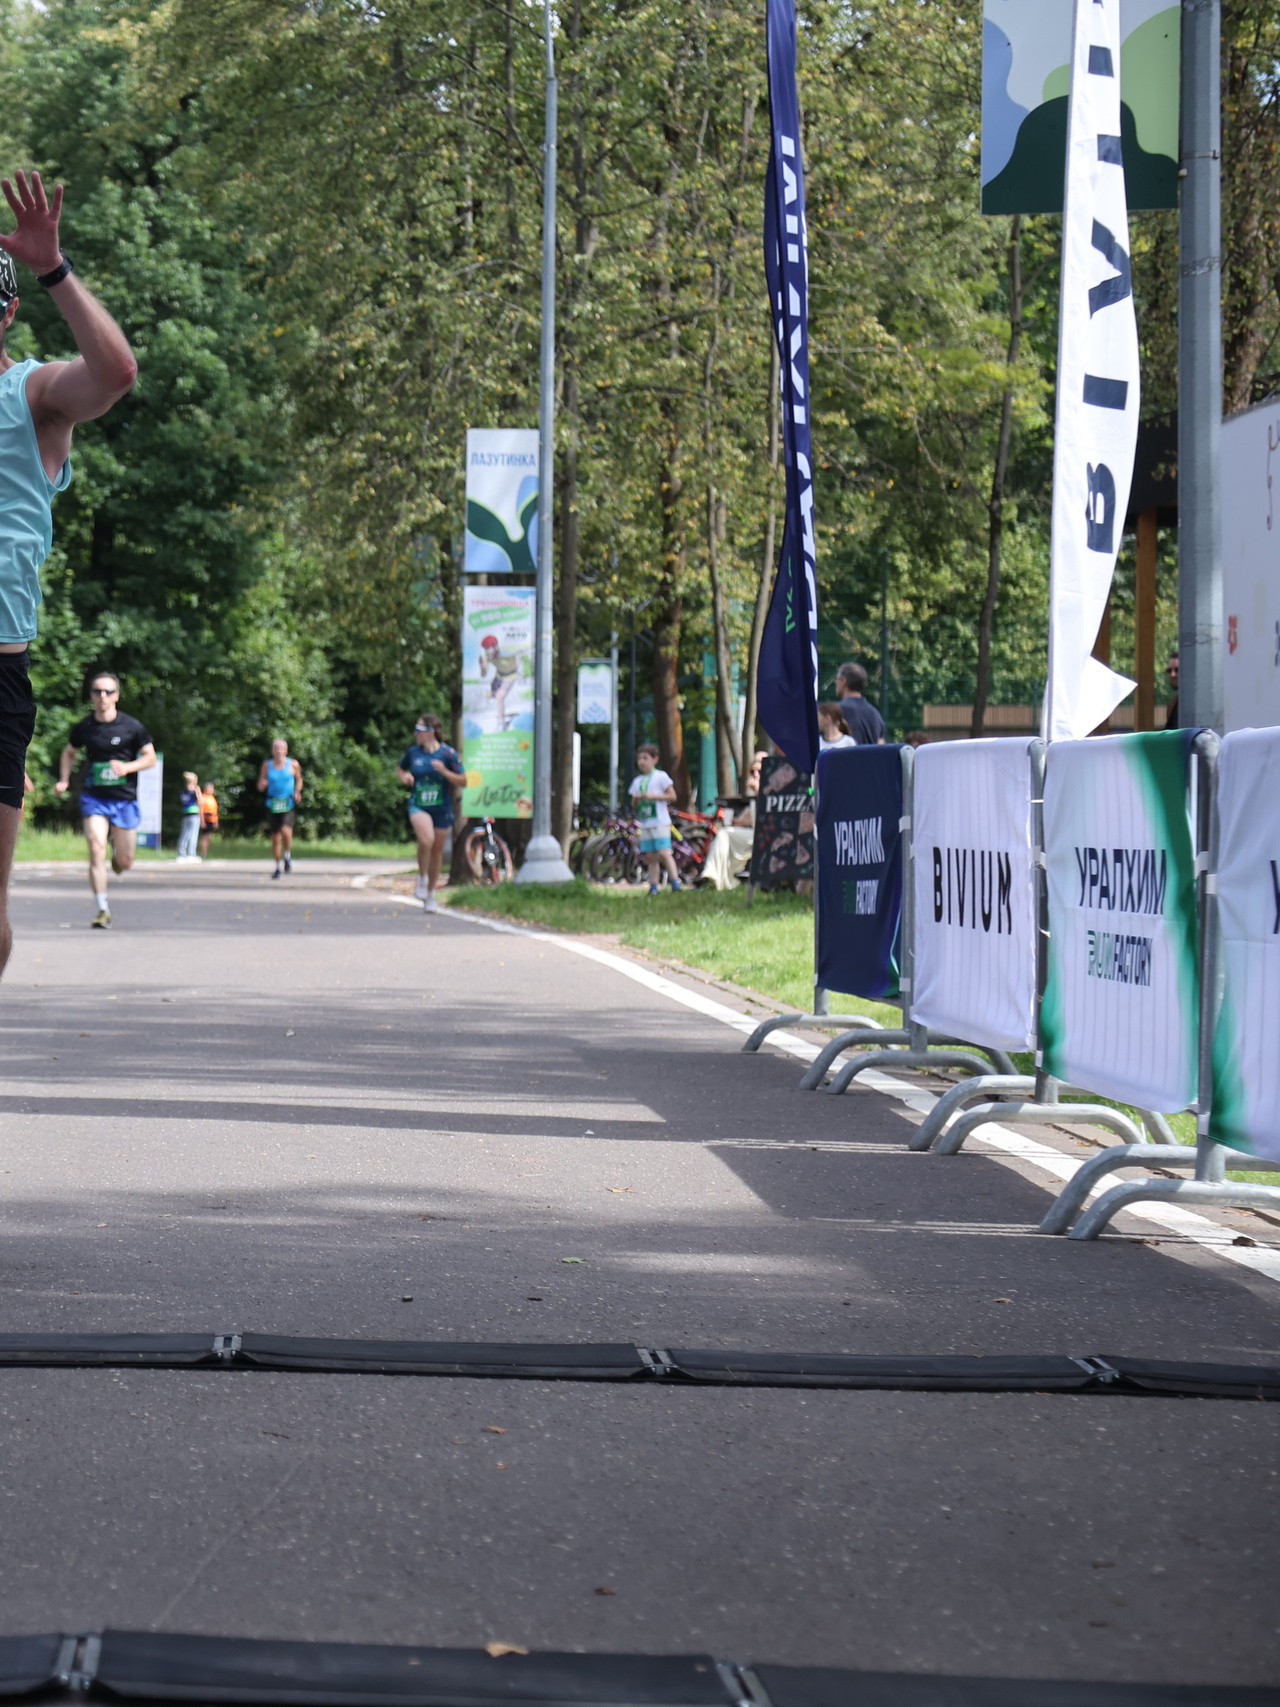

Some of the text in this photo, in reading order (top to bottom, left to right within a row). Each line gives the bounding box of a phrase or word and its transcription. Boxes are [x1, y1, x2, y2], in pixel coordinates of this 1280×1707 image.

[471, 452, 536, 466] ЛАЗУТИНКА
[834, 816, 885, 866] УРАЛХИМ
[933, 846, 1012, 935] BIVIUM
[1075, 847, 1167, 915] УРАЛХИМ
